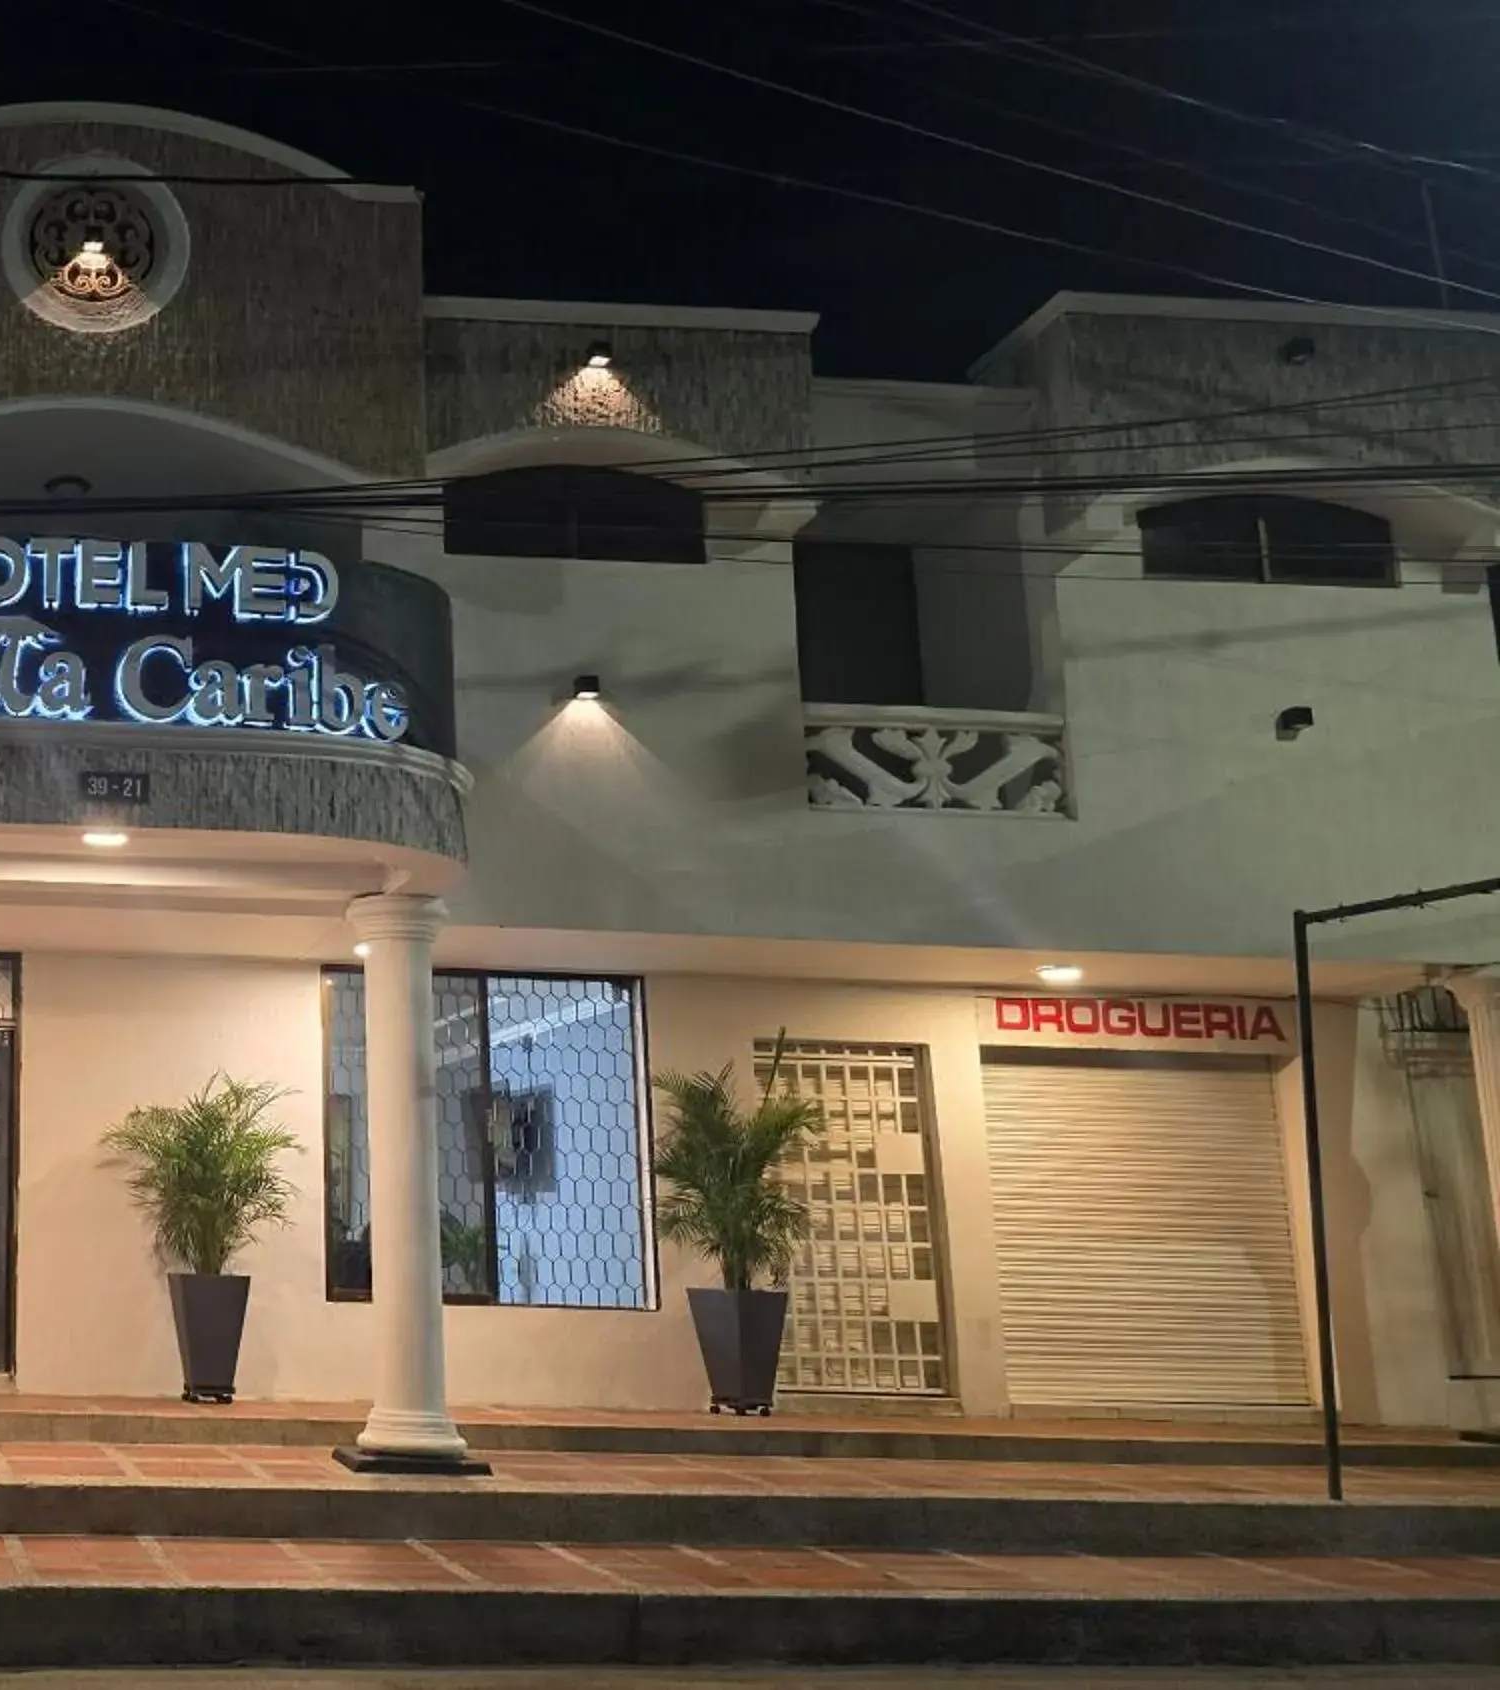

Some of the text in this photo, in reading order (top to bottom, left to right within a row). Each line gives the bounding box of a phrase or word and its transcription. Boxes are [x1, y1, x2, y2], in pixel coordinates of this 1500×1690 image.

[184, 542, 339, 623] MED
[114, 634, 409, 742] Caribe
[996, 997, 1286, 1041] DROGUERIA
